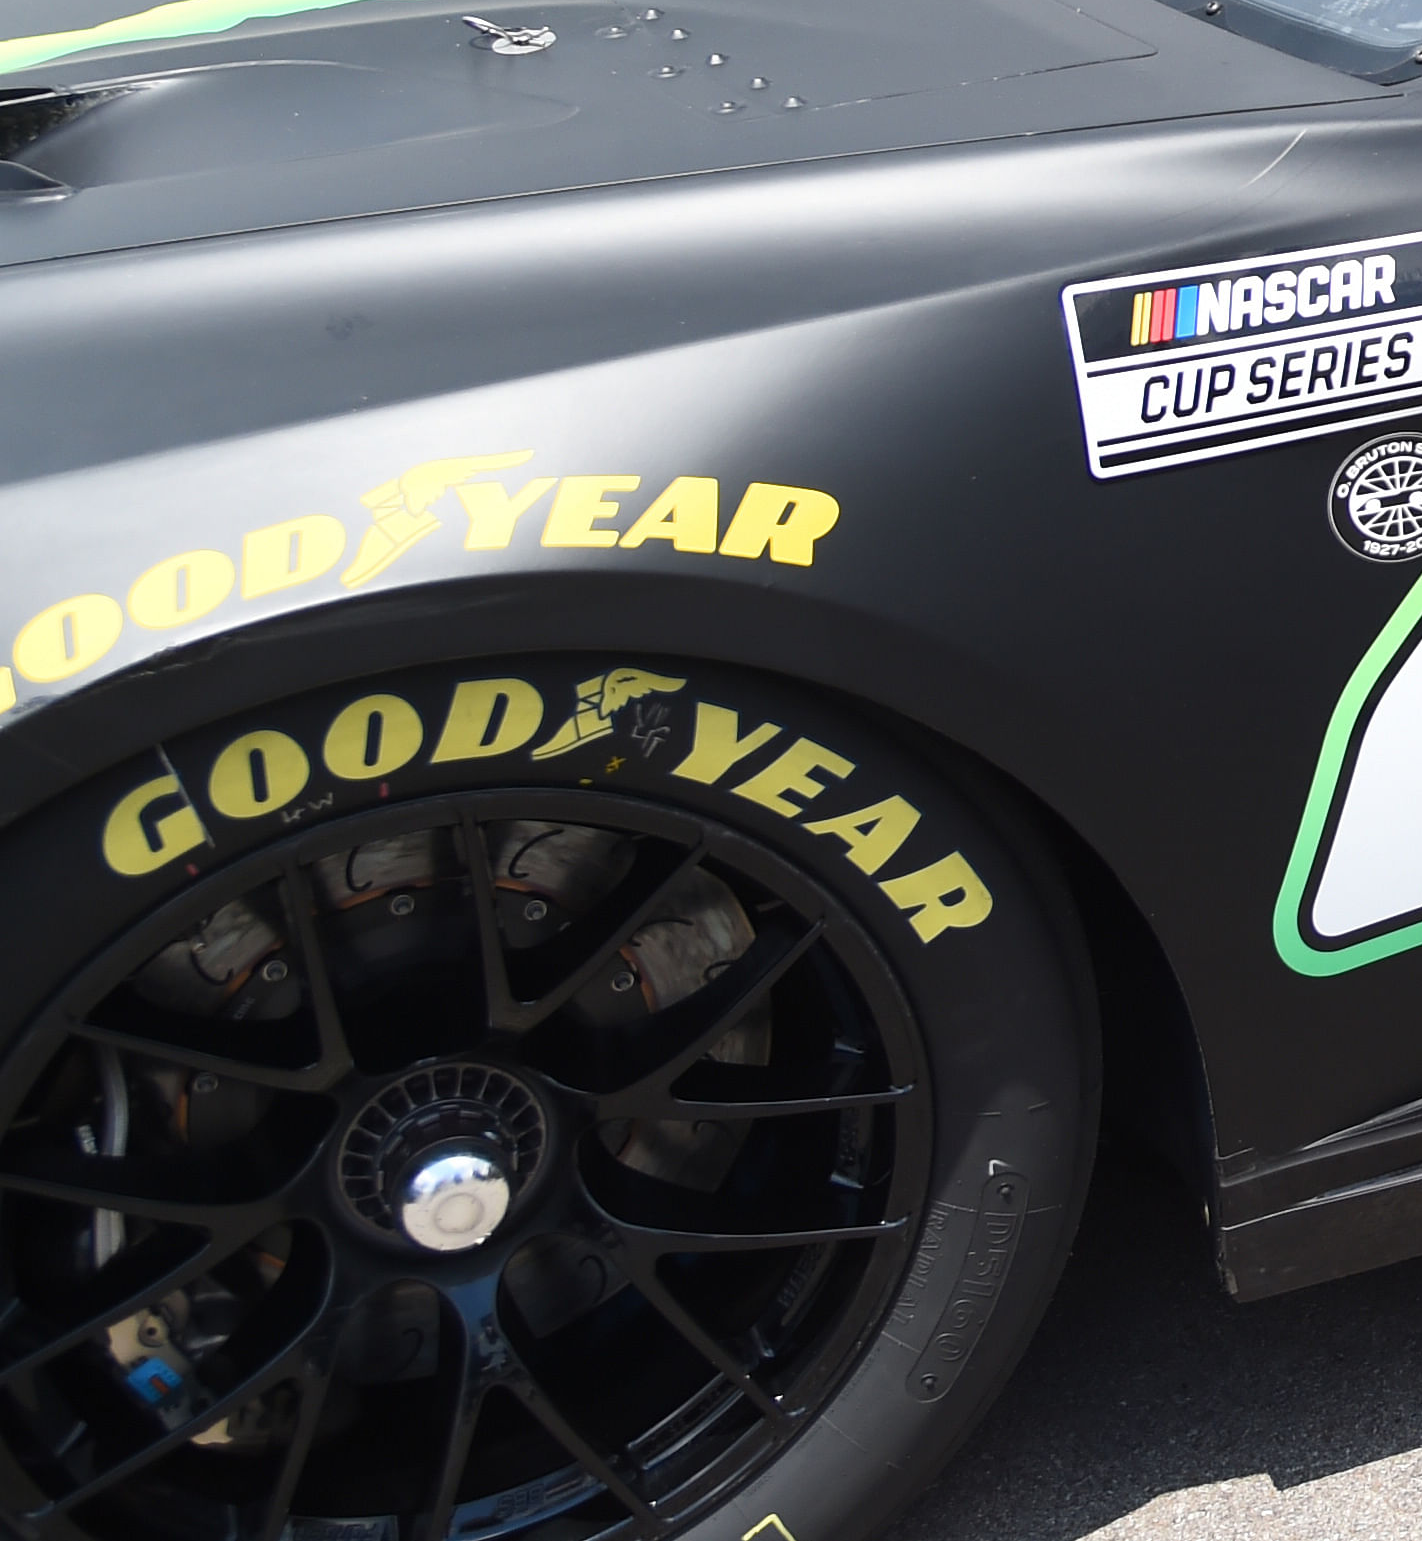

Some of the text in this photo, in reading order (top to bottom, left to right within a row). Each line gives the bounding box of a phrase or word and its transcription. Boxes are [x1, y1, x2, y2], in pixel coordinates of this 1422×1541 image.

[1196, 253, 1397, 337] NASCAR
[1140, 331, 1415, 424] CUP SERIES
[1345, 441, 1413, 480] BRUTON
[0, 450, 840, 716] OODYEAR
[102, 668, 994, 944] GOODYEAR
